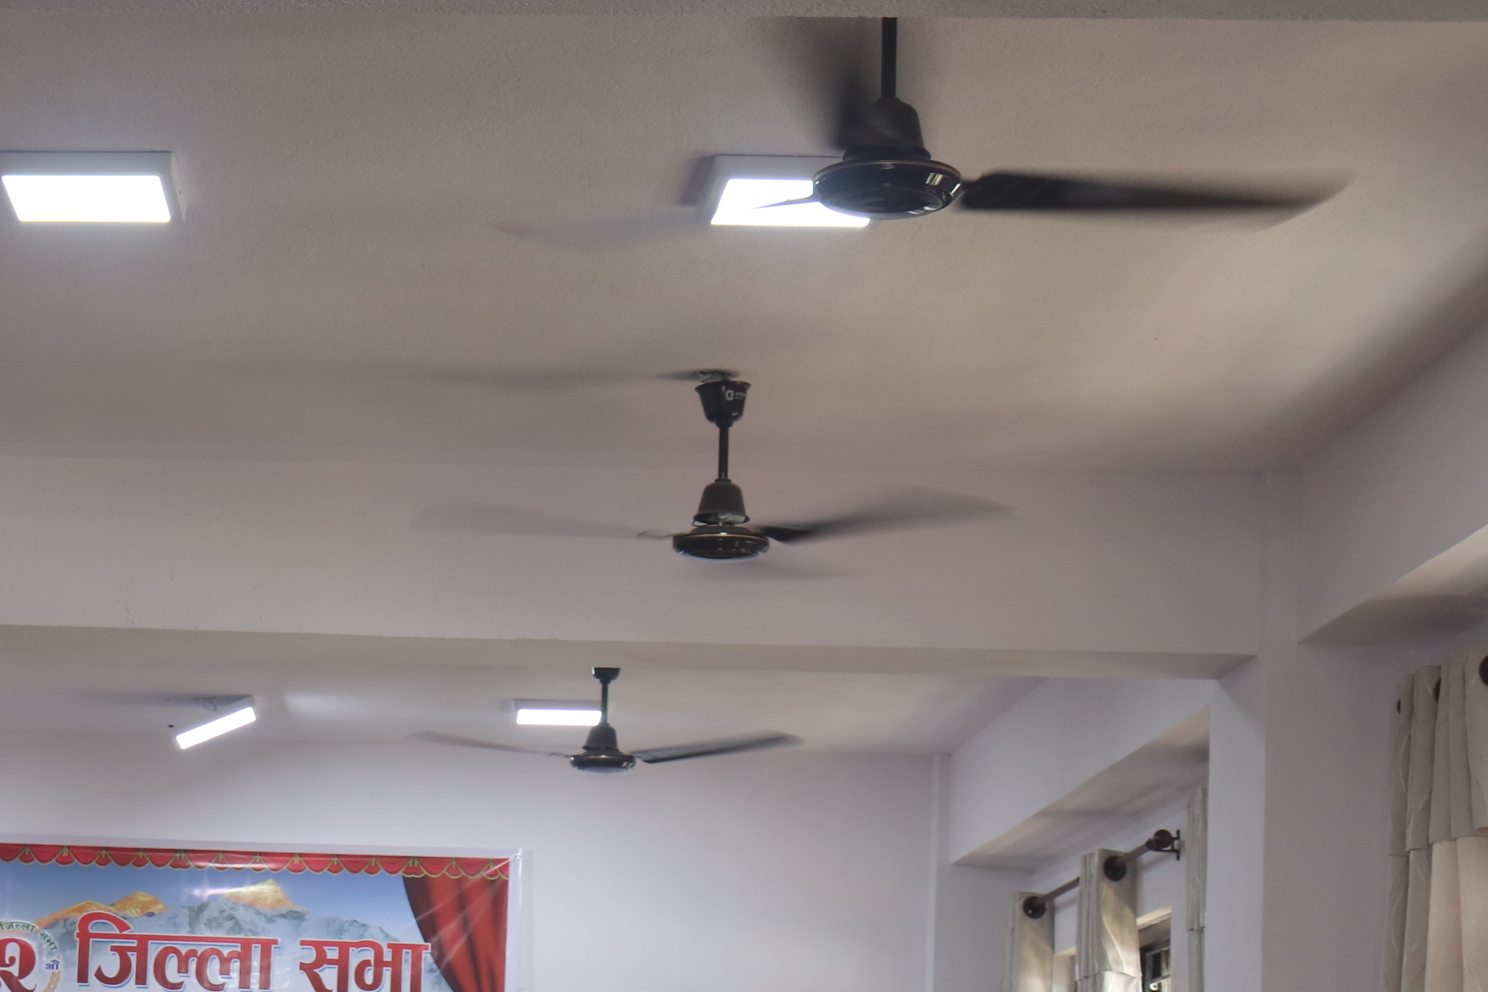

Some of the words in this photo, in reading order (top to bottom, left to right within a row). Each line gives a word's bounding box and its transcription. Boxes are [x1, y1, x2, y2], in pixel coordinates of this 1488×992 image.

[0, 920, 36, 932] जिल्ला
[40, 931, 59, 951] सभा
[76, 911, 280, 992] जिल्ला
